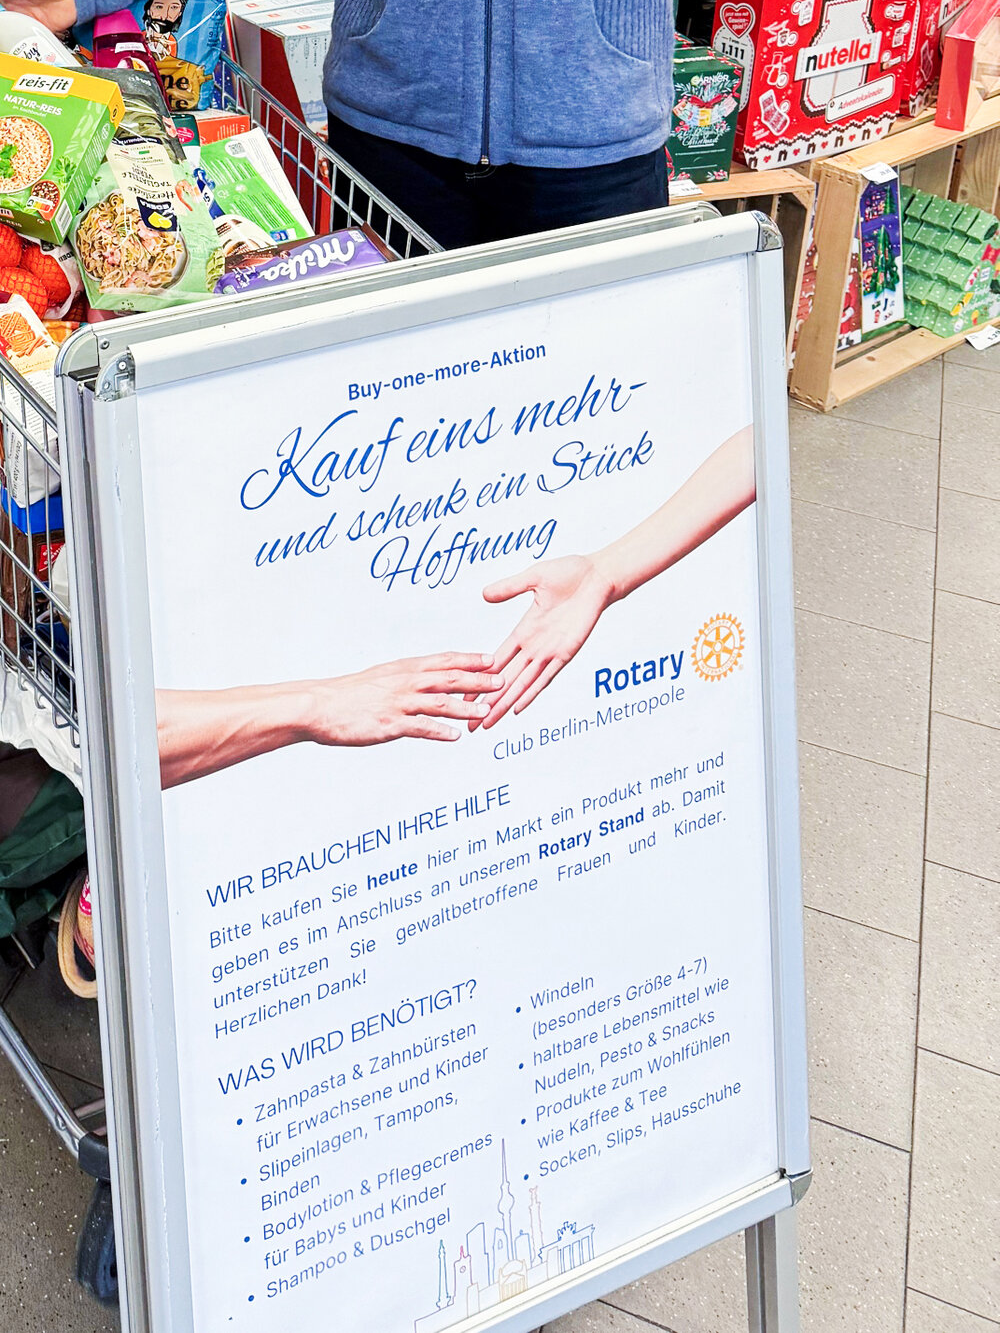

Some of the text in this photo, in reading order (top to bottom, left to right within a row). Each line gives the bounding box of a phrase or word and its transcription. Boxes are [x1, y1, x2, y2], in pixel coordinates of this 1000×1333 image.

[18, 76, 71, 92] reis-fit
[804, 39, 873, 74] nutella
[3, 93, 63, 116] NATUR-REIS
[258, 236, 356, 282] Milka
[347, 344, 547, 402] Buy-one-more-Aktion
[240, 374, 648, 510] Kauf eins mehr-
[254, 430, 655, 567] und schenk ein Stück
[370, 518, 558, 593] Hoffnung
[595, 650, 686, 699] Rotary
[493, 685, 686, 761] Club Berlin-Metropole
[205, 783, 511, 908] WIR BRAUCHEN IHRE HILFE
[209, 750, 724, 950] Bitte kaufen Sie heute hier im Markt ein Produkt mehr und
[211, 779, 726, 984] geben es im Anschluss an unserem Rotary Stand ab. Damit
[213, 810, 727, 1010] unterstützen Sie gewaltbetroffene Frauen und Kinder.
[214, 968, 367, 1040] Herzlichen Dank!
[217, 978, 477, 1095] WAS WIRD BENÖTIGT?
[529, 976, 594, 1010] Windeln
[532, 956, 708, 1041] (besonders Größe 4-7)
[533, 978, 730, 1067] haltbare Lebensmittel wie
[254, 1023, 477, 1123] Zahnpasta & Zahnbürsten
[534, 1010, 715, 1095] Nudeln, Pesto & Snacks
[536, 1031, 731, 1122] Produkte zum Wohlfühlen
[256, 1046, 489, 1153] für Erwachsene und Kinder
[259, 1091, 458, 1182] Slipeinlagen, Tampons,
[537, 1085, 668, 1149] wie Kaffee & Tee
[539, 1081, 742, 1177] Socken, Slips, Hausschuhe
[261, 1174, 321, 1212] Binden
[262, 1133, 493, 1241] Bodylotion & Pflegecremes
[263, 1182, 447, 1270] für Babys und Kinder
[266, 1206, 451, 1299] Shampoo & Duschgel
